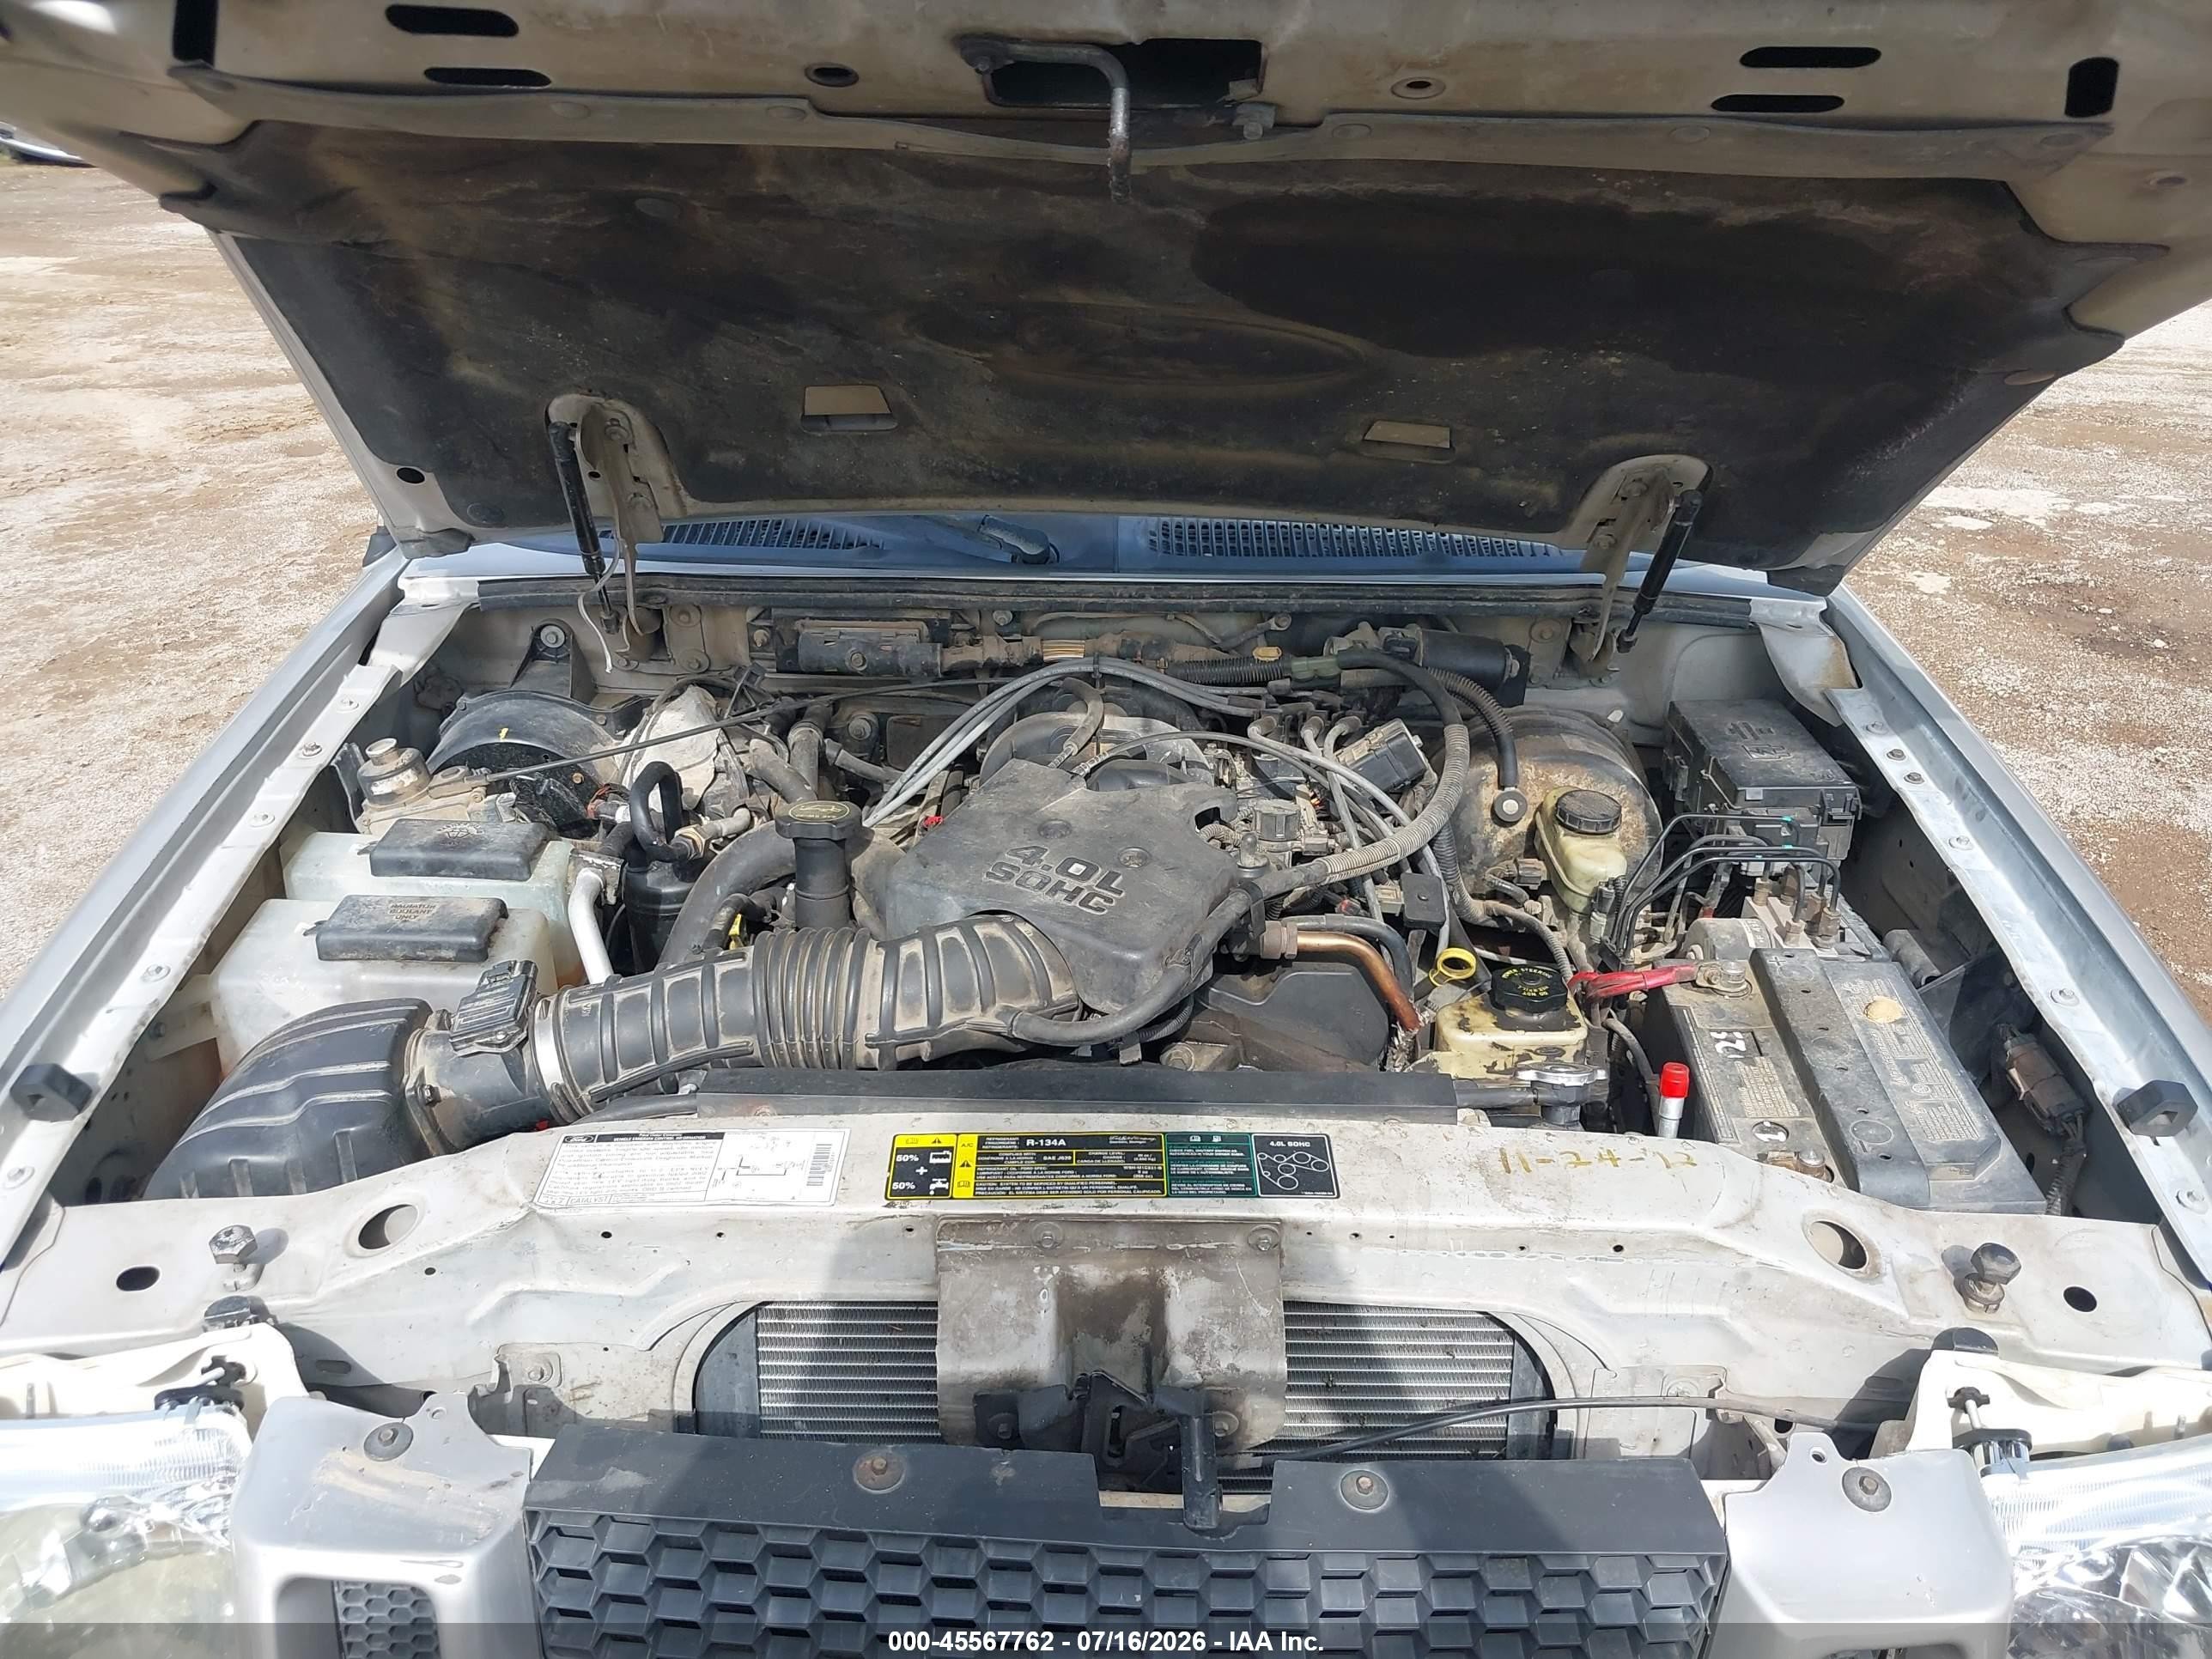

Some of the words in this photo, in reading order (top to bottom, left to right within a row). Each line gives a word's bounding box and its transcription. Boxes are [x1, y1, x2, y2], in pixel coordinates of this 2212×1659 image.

[984, 861, 1115, 914] SOHC
[1006, 845, 1125, 897] 4.0L
[892, 1182, 916, 1190] 50%
